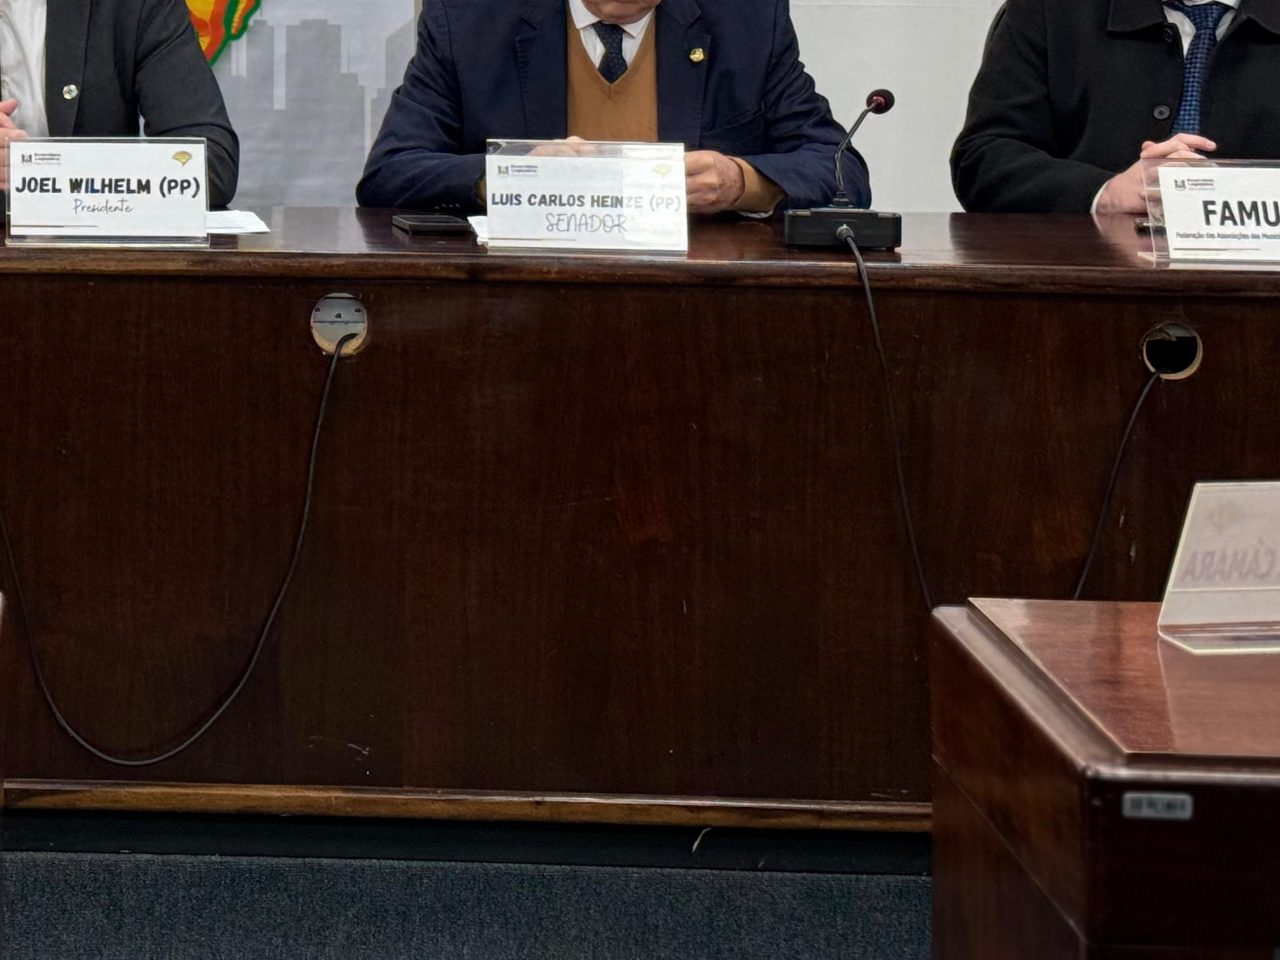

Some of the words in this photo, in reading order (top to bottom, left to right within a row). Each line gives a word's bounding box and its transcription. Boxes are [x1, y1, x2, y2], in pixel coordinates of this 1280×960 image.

[15, 177, 62, 193] JOEL
[70, 178, 151, 194] WILHELM
[159, 176, 201, 198] (PP)
[73, 198, 133, 214] Presidente
[491, 193, 522, 206] LUIS
[527, 193, 585, 207] CARLOS
[590, 194, 643, 208] HEINZE
[649, 195, 681, 212] (PP)
[545, 212, 628, 233] SENADOR
[1202, 200, 1280, 227] FAMU
